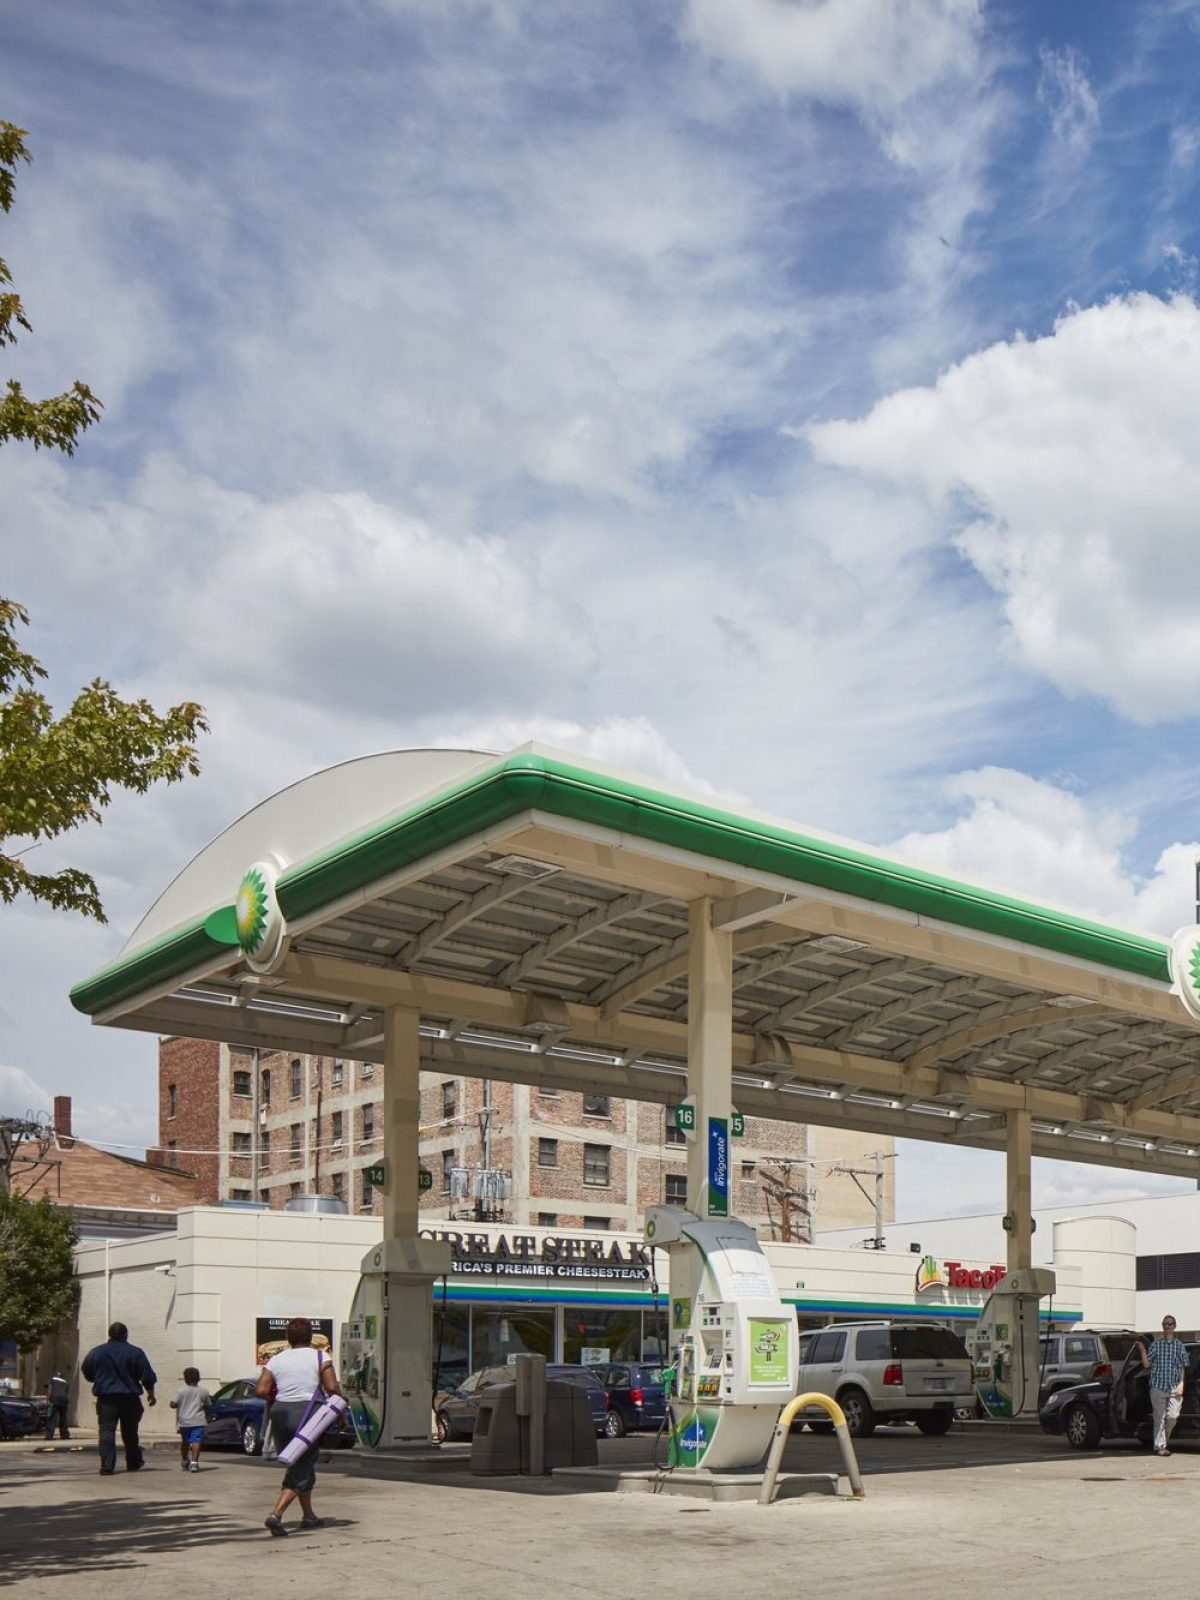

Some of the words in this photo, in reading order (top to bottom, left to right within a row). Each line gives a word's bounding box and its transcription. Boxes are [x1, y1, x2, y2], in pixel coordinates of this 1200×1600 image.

[678, 1109, 692, 1124] 16
[717, 1137, 727, 1187] Invigorate
[370, 1169, 383, 1182] 14
[420, 1173, 431, 1186] 13
[542, 1236, 652, 1265] STEAK
[451, 1261, 493, 1273] RICA'S
[496, 1264, 554, 1276] PREMIER
[557, 1266, 646, 1279] CHEESESTEAK
[944, 1262, 1007, 1290] TacoT
